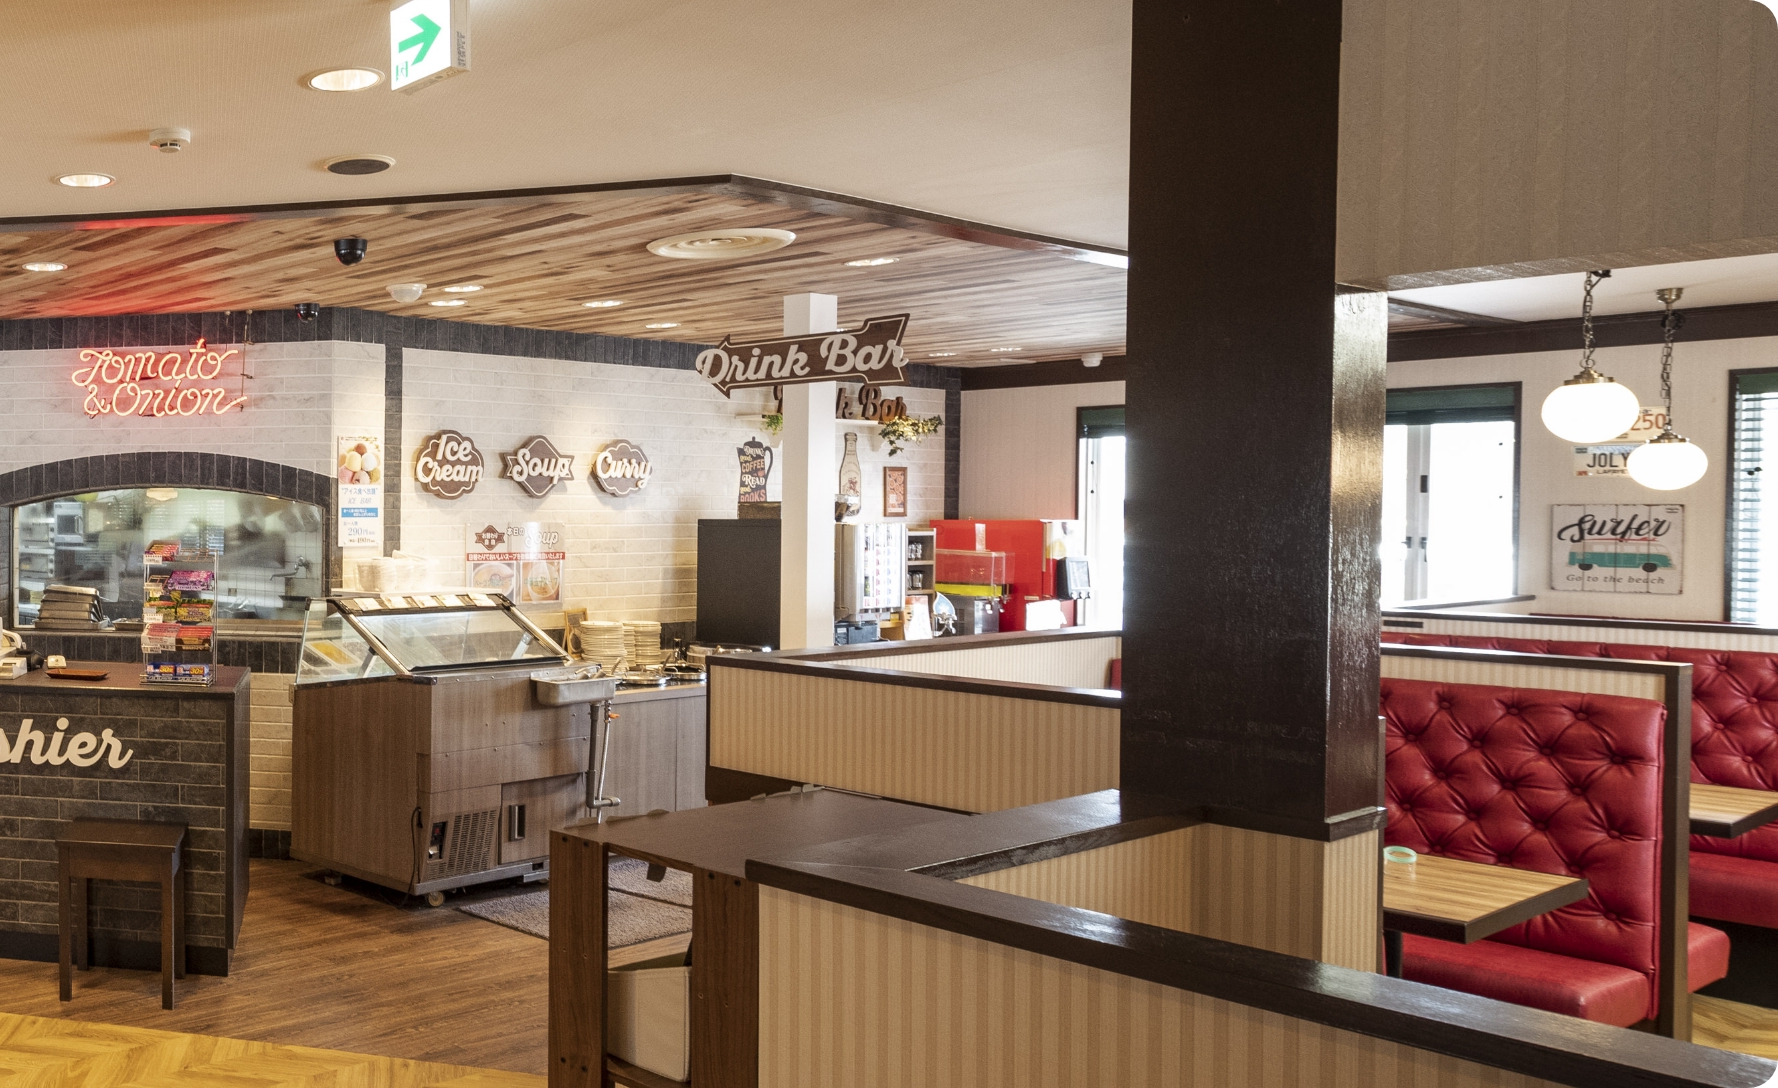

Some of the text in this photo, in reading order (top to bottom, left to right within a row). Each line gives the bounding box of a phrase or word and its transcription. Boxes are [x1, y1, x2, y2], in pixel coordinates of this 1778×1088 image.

[72, 338, 238, 387] Tomato
[696, 334, 910, 384] Drink Bar
[84, 380, 248, 417] & Onion
[436, 434, 473, 463] Ice
[416, 459, 484, 484] Cream
[512, 448, 570, 485] Soup
[595, 451, 653, 488] Curry
[741, 459, 765, 472] COFFEE
[742, 474, 765, 488] READ
[506, 527, 559, 549] 本日の Soup
[1557, 514, 1671, 543] Surfer
[1566, 574, 1665, 584] Go to the beach
